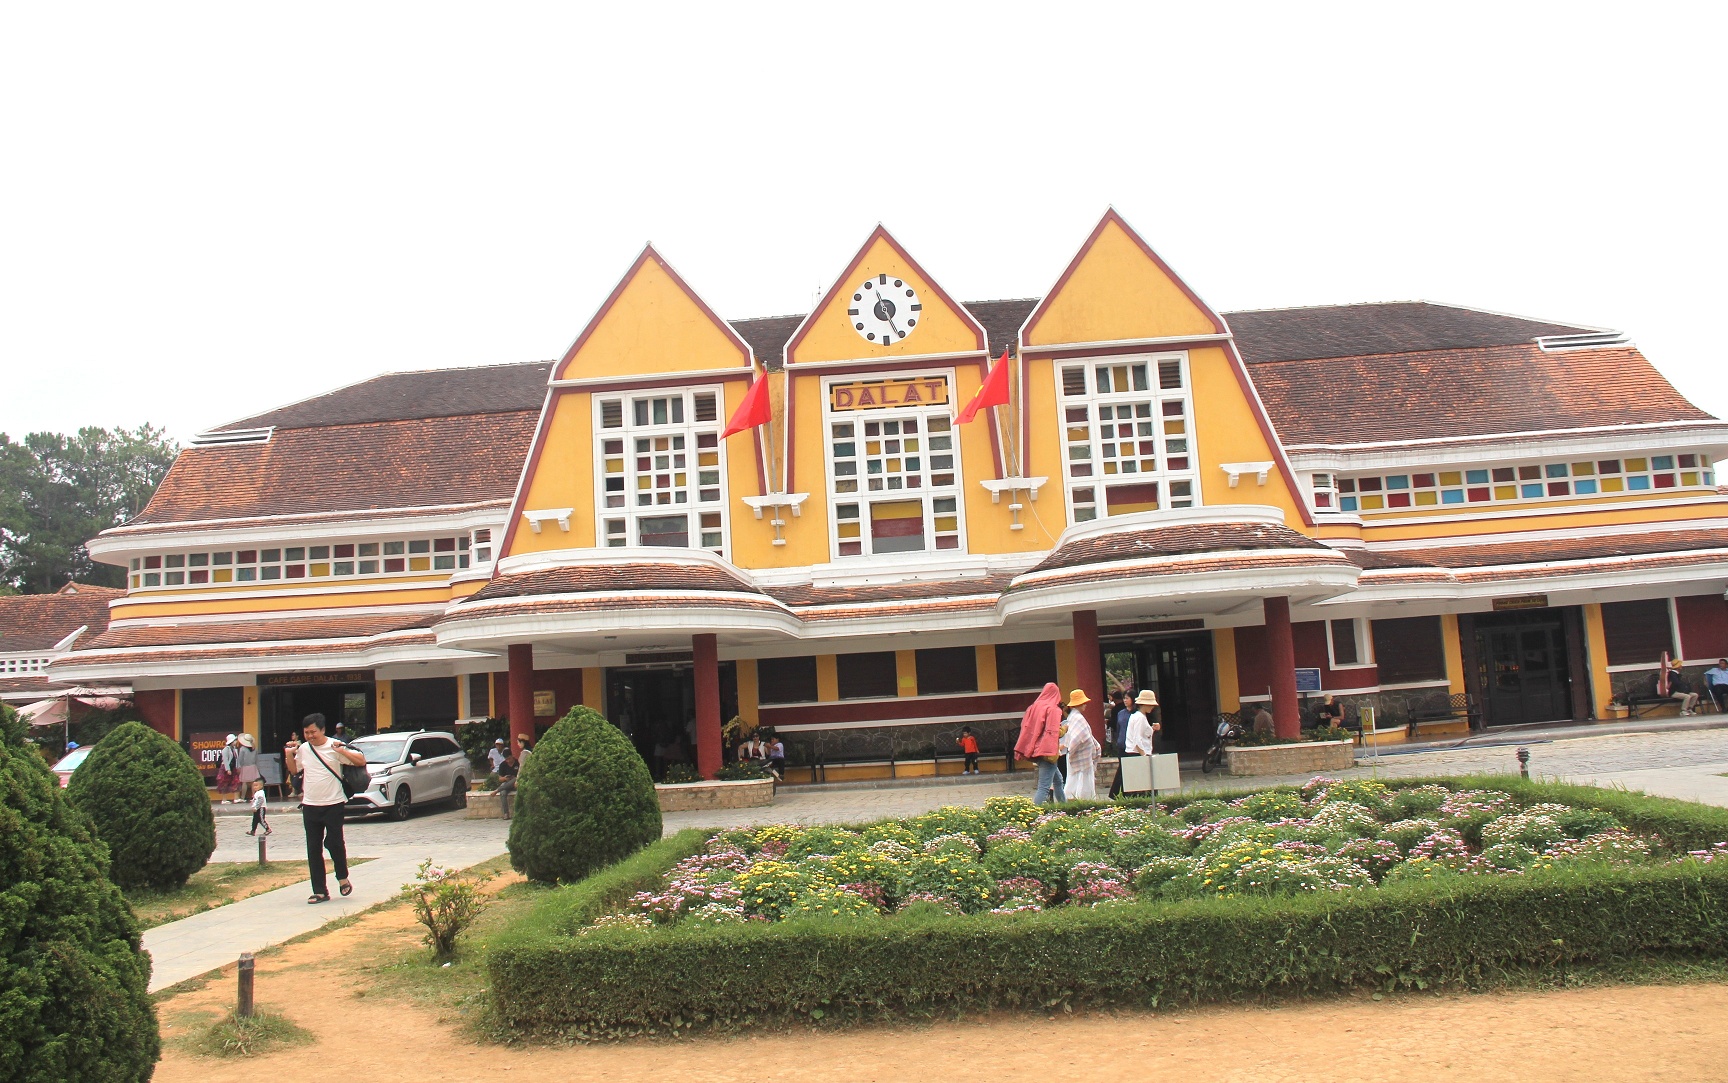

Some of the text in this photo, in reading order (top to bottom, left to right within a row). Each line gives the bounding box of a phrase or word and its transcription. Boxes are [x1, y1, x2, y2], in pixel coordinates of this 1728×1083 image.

[835, 381, 942, 408] DALAT
[290, 675, 311, 683] GARE
[313, 674, 338, 682] DALAT
[346, 673, 361, 681] 1938
